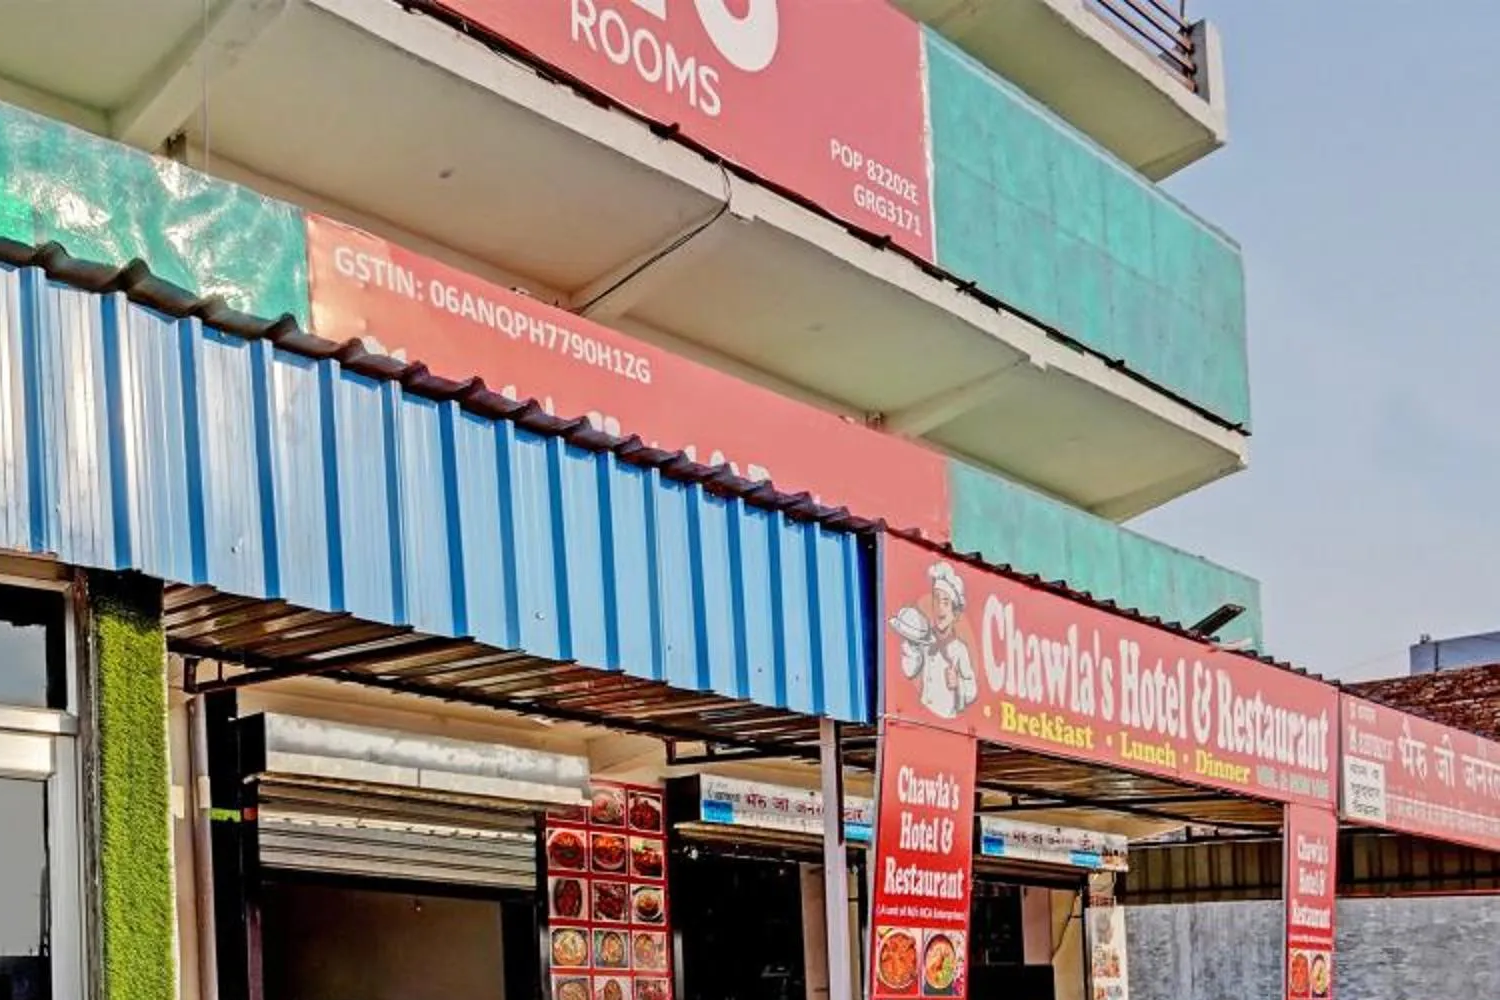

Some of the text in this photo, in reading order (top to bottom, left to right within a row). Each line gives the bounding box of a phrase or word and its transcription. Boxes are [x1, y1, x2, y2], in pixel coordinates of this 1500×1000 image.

[571, 0, 721, 117] ROOMS
[830, 139, 863, 172] POP
[853, 183, 922, 237] GRG3171
[334, 247, 652, 385] GSTIN: 06ANQPH7790H1ZG
[982, 593, 1330, 774] Chawla's Hotel & Restaurant
[999, 700, 1095, 750] Brekfast
[1120, 731, 1177, 769] Lunch
[1195, 749, 1250, 785] Dinner
[897, 764, 960, 811] Chawla's
[899, 811, 954, 855] Hotel &
[884, 856, 965, 900] Restaurant
